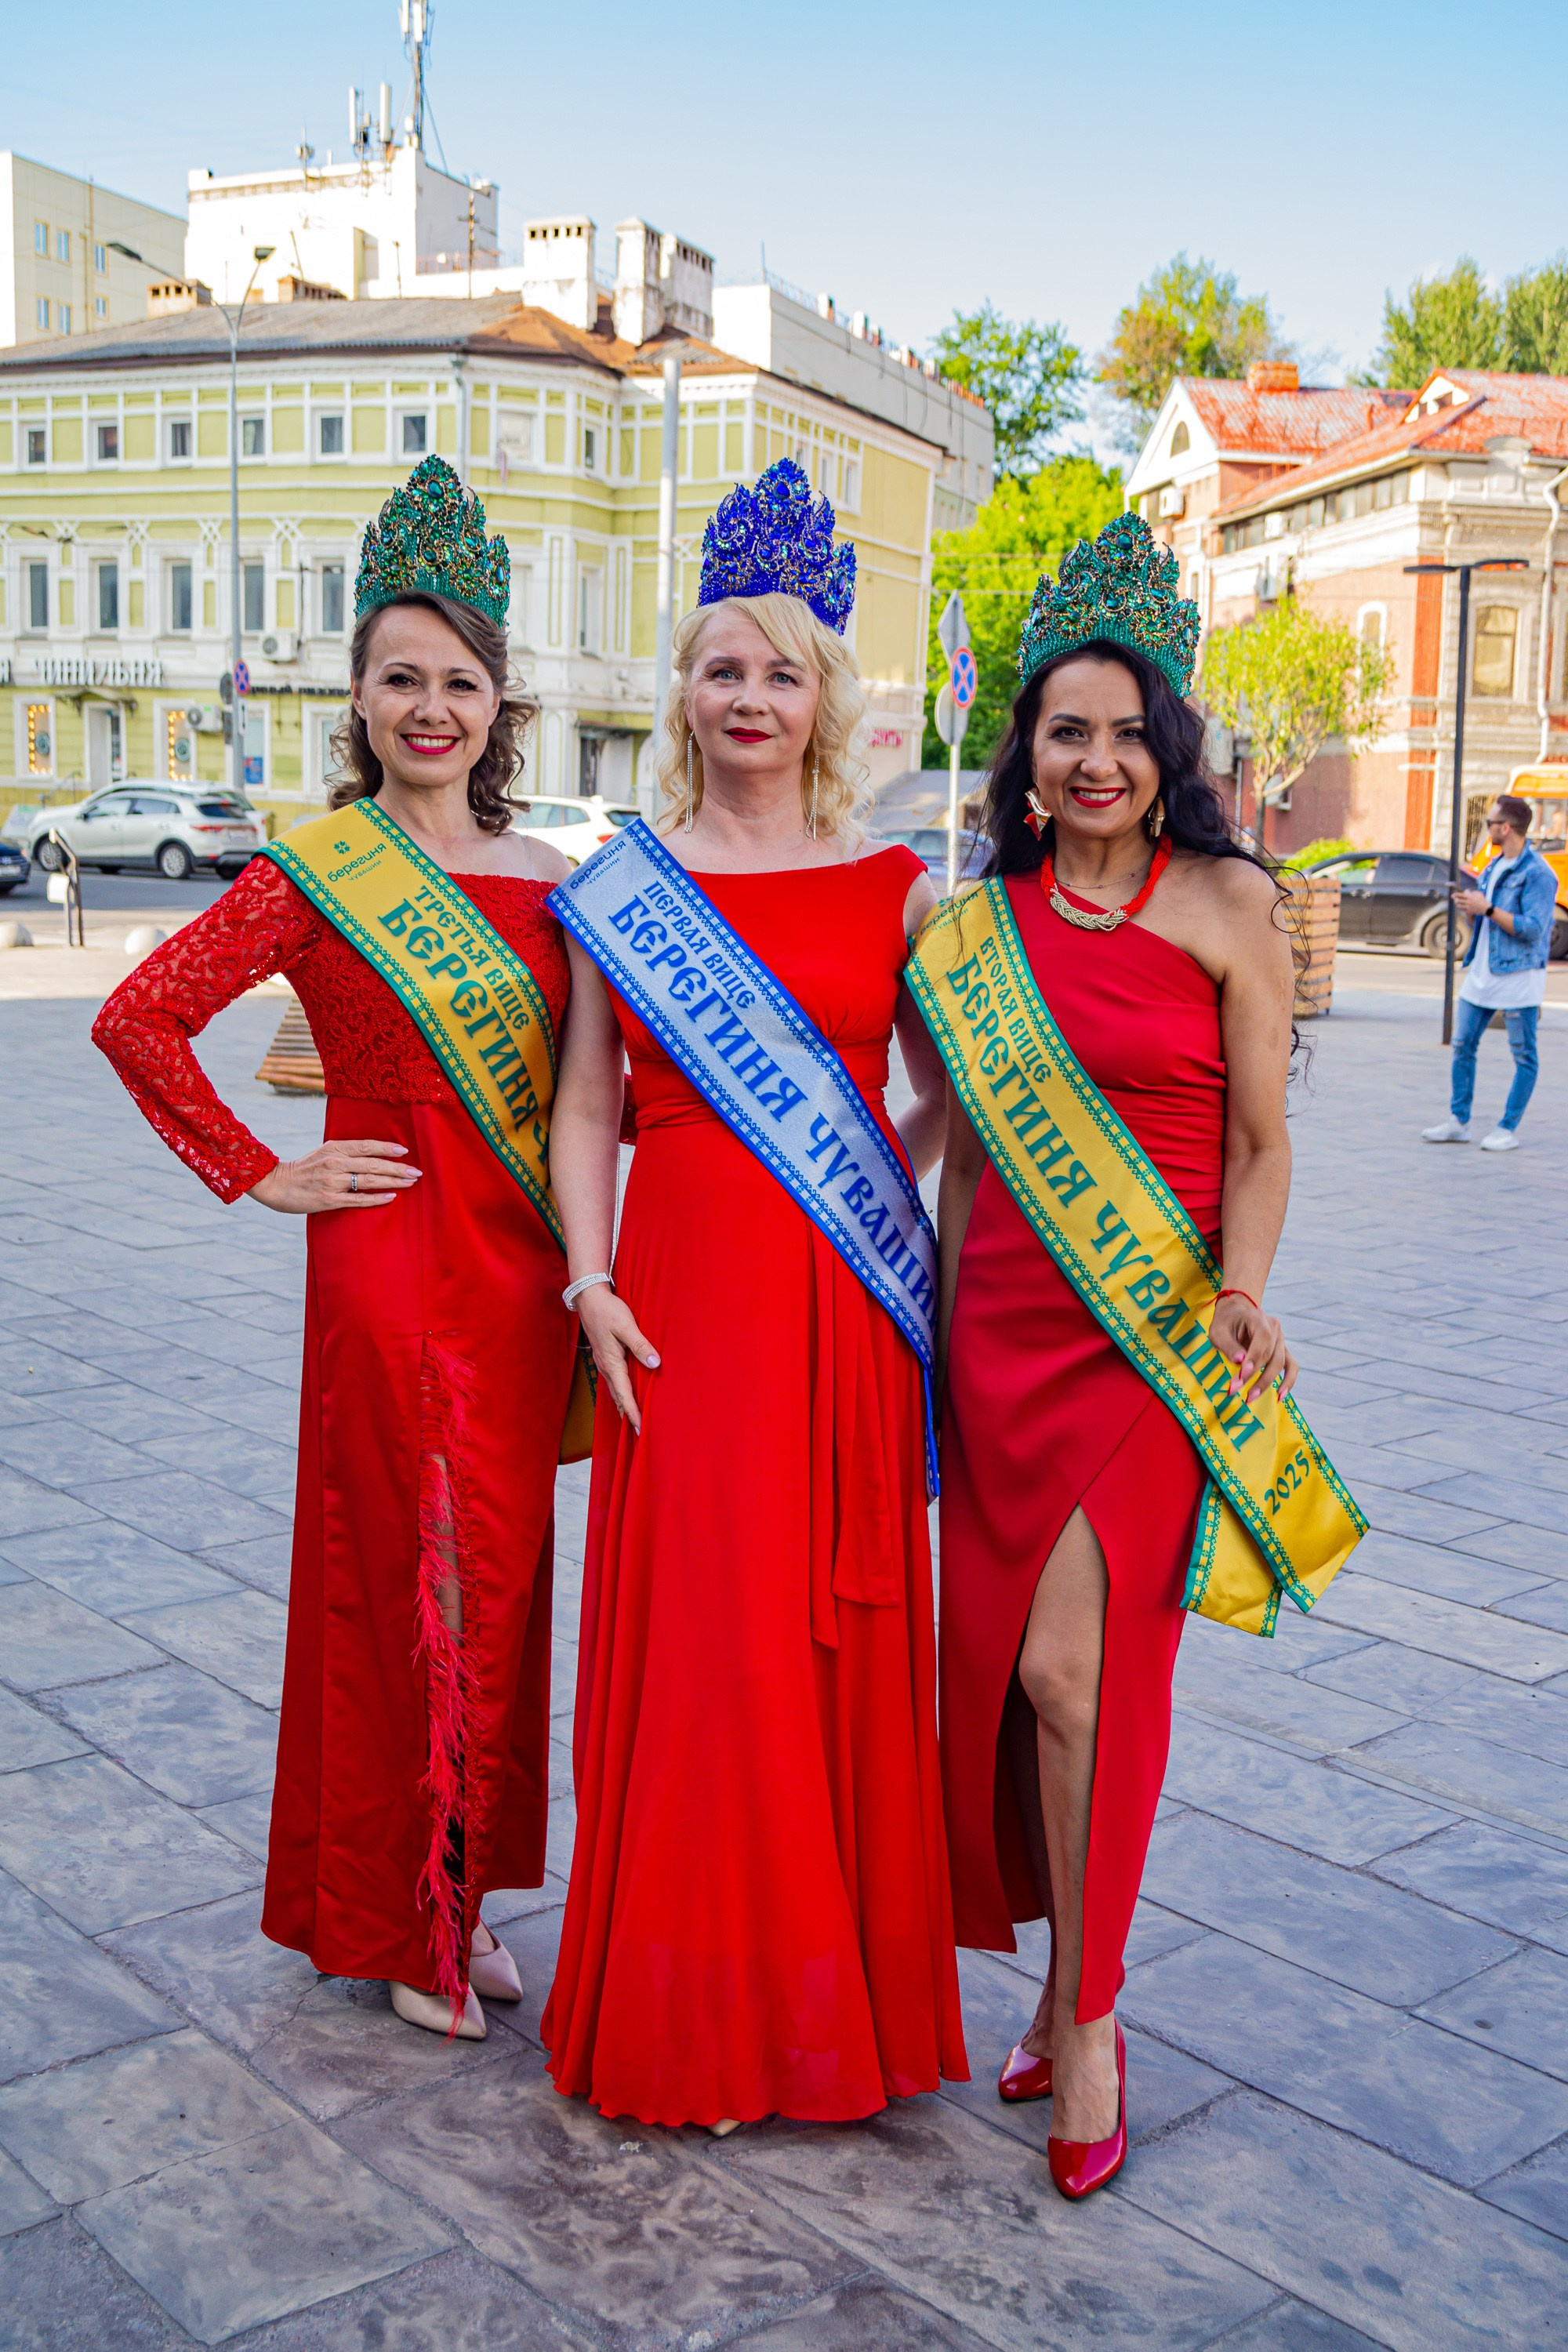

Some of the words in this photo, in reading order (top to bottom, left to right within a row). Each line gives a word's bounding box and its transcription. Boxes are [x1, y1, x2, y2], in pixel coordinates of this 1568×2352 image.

[327, 843, 387, 882] берегиня
[570, 840, 626, 890] берегиня
[377, 898, 539, 1132] БЕРЕГИНЯ
[414, 884, 492, 969] ТРЕТЬЯ
[484, 967, 531, 1031] ВИЦЕ
[608, 895, 808, 1123] БЕРЕГИНЯ
[643, 880, 712, 955] ПЕРВАЯ
[702, 953, 756, 1009] ВИЦЕ
[980, 935, 1018, 1019] ВТОРАЯ
[1008, 1017, 1051, 1083] ВИЦЕ
[946, 952, 1098, 1208] БЕРЕГИНЯ
[1091, 1200, 1265, 1453] ЧУВАШИИ
[1264, 1449, 1309, 1516] 2025
